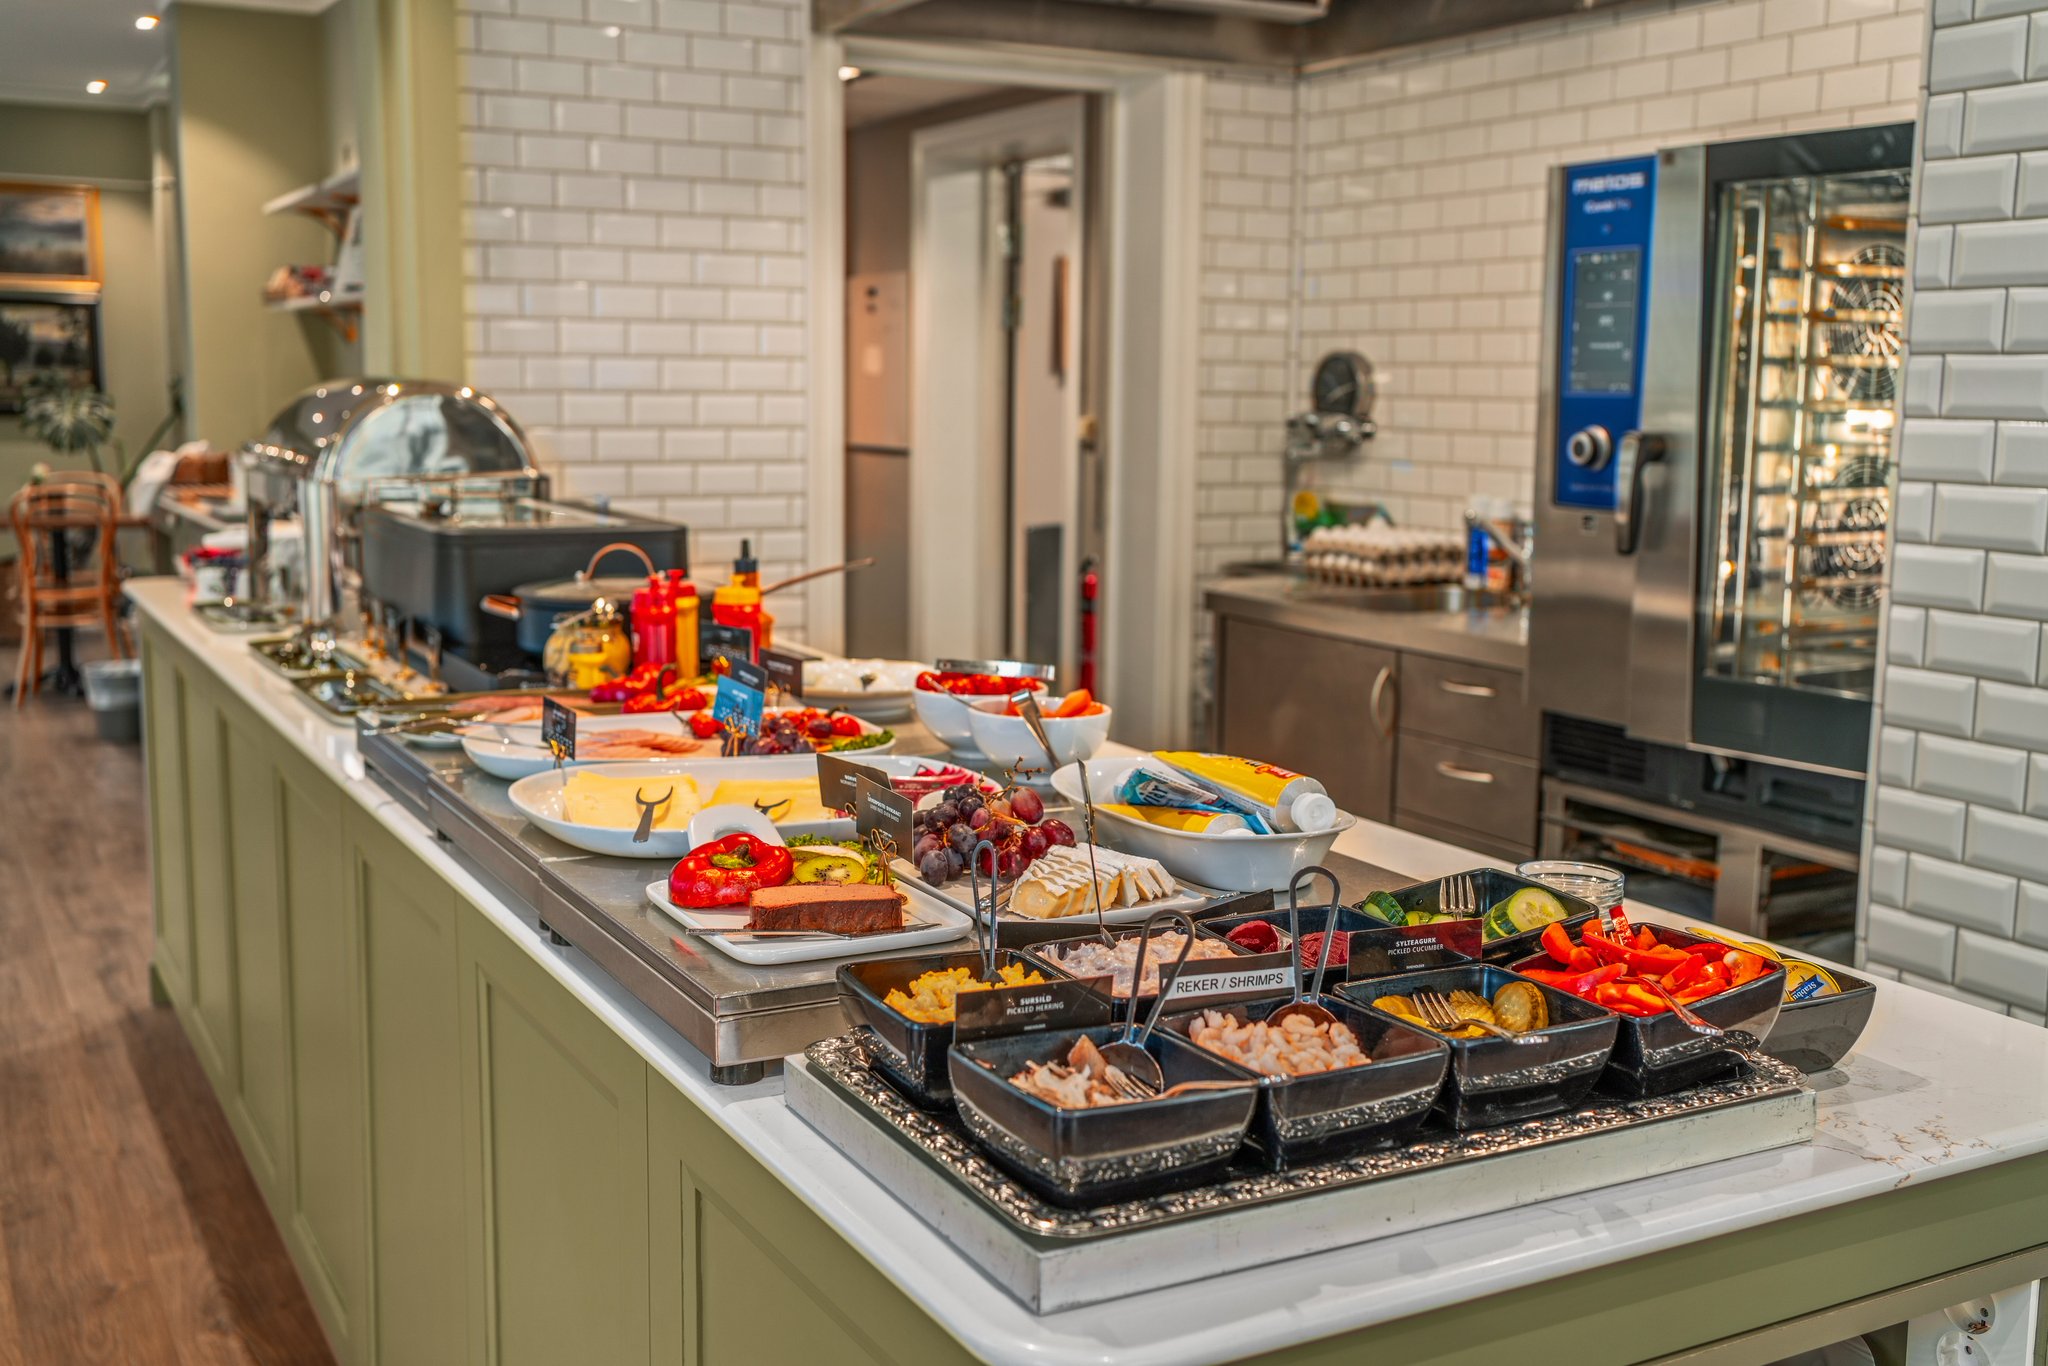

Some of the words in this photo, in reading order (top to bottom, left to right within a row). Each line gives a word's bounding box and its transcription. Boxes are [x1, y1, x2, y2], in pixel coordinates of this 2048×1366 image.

[1395, 937, 1437, 947] SYLTEAGURK
[1388, 947, 1411, 956] PICKLED
[1413, 944, 1444, 953] CUCUMBER
[1176, 978, 1219, 994] REKER
[1221, 978, 1227, 989] /
[1228, 972, 1284, 989] SHRIMPS
[1020, 994, 1052, 1006] SURSILD
[1006, 1006, 1034, 1016] PICKLED
[1035, 1001, 1065, 1012] HERRING
